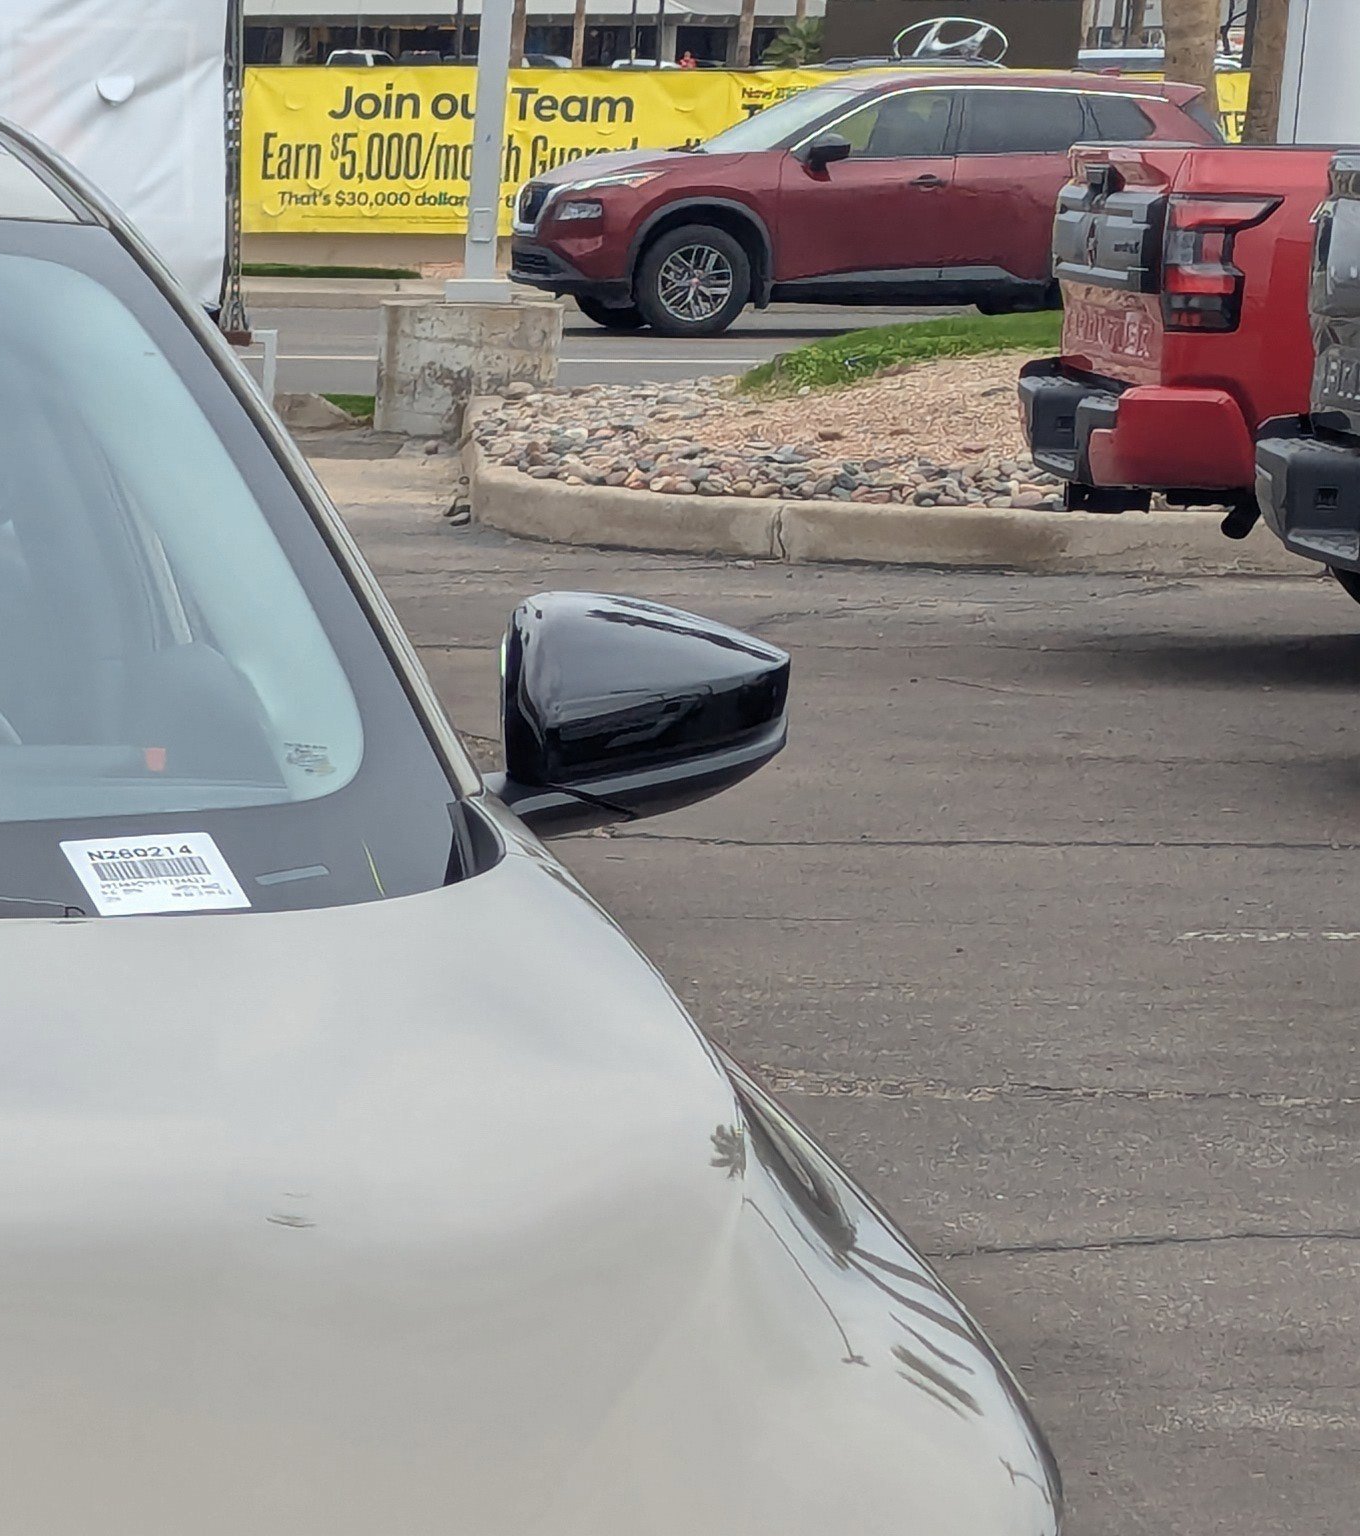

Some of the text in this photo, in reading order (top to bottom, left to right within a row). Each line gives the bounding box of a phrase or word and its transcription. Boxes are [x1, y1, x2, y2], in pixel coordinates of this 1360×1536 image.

[328, 83, 635, 123] Join ou Team
[261, 132, 322, 180] Earn
[330, 131, 521, 184] $5,000/moh
[278, 190, 470, 207] That's $30,000 dollar
